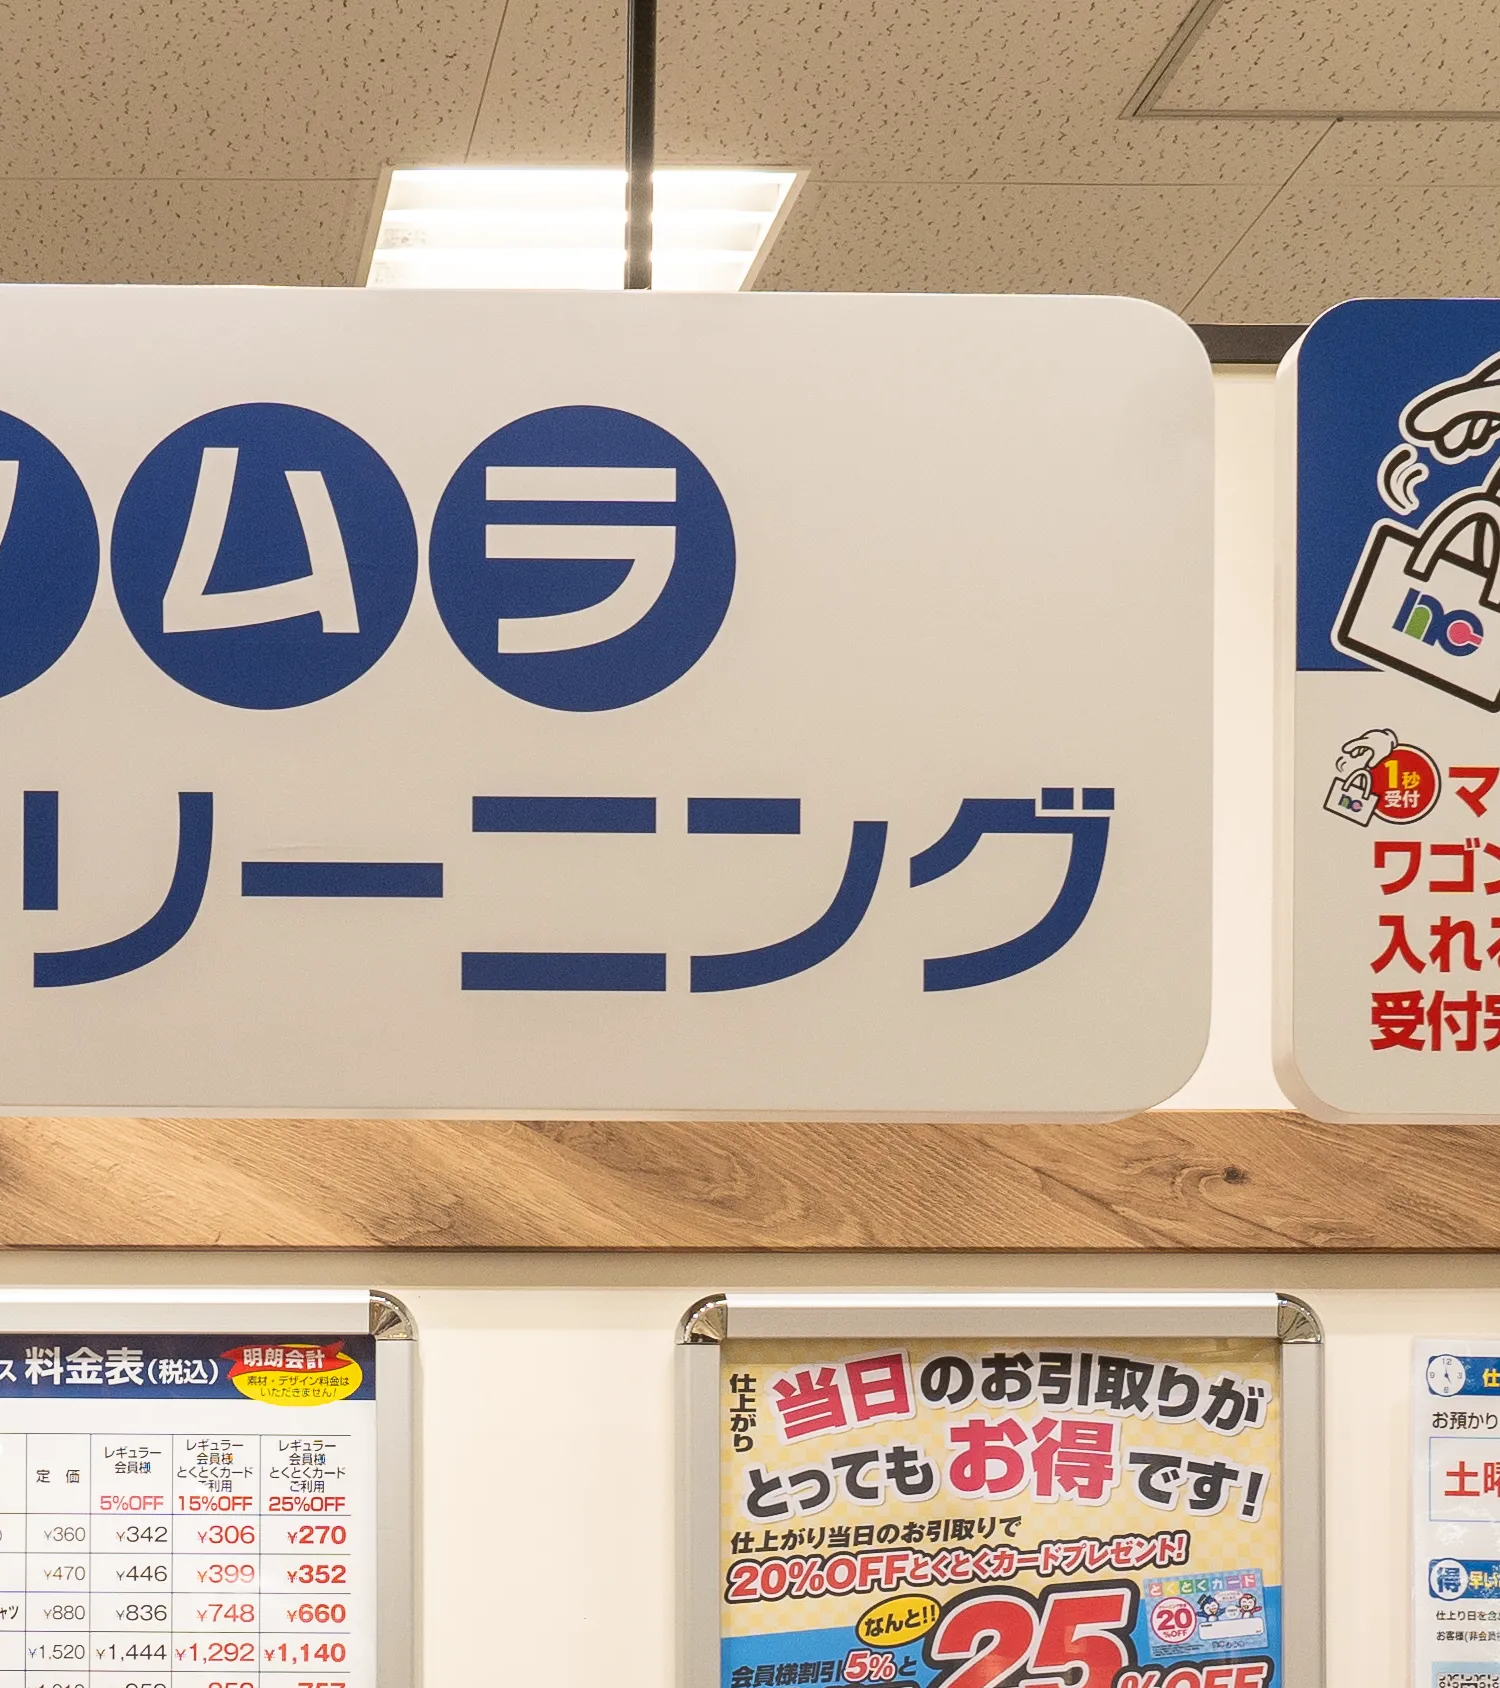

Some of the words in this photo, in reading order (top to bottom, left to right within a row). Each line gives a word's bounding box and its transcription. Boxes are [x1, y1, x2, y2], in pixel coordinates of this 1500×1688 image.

[243, 1347, 325, 1369] 明朗会計
[247, 1375, 349, 1387] 素材・デザイン料金は
[260, 1387, 337, 1398] いただきません!
[729, 1373, 756, 1452] 仕上がり
[269, 1467, 346, 1479] とくとくカード
[100, 1495, 163, 1511] 5%OFF
[179, 1495, 253, 1511] 15%OFF
[268, 1496, 345, 1512] 25%OFF
[287, 1525, 346, 1544] ¥270
[731, 1516, 1023, 1554] 仕上がり当日のお引取りで
[287, 1565, 346, 1584] ¥352
[287, 1604, 346, 1623] ¥660
[264, 1642, 346, 1665] ¥1,140
